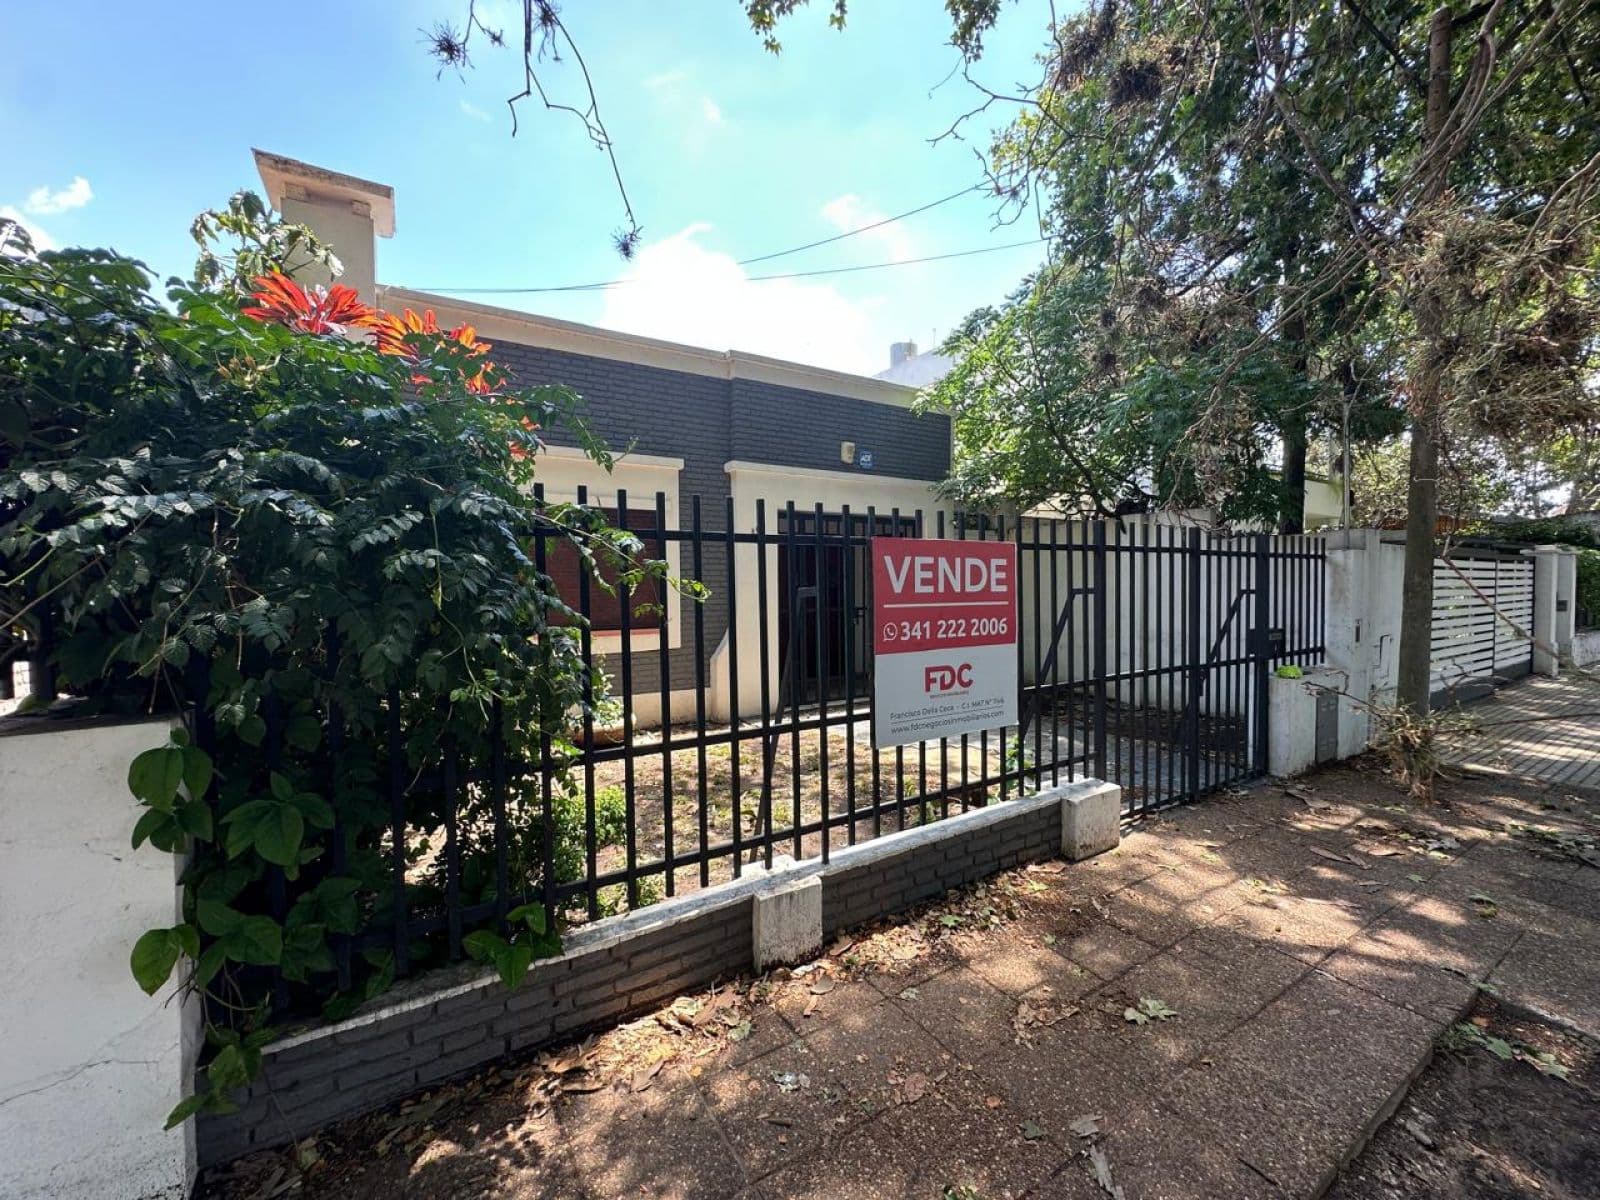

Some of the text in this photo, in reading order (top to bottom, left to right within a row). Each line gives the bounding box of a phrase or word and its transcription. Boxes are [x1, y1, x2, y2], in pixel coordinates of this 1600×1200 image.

[884, 555, 1007, 593] VENDE
[900, 617, 1008, 641] 341 222 2006
[925, 663, 973, 692] FDC
